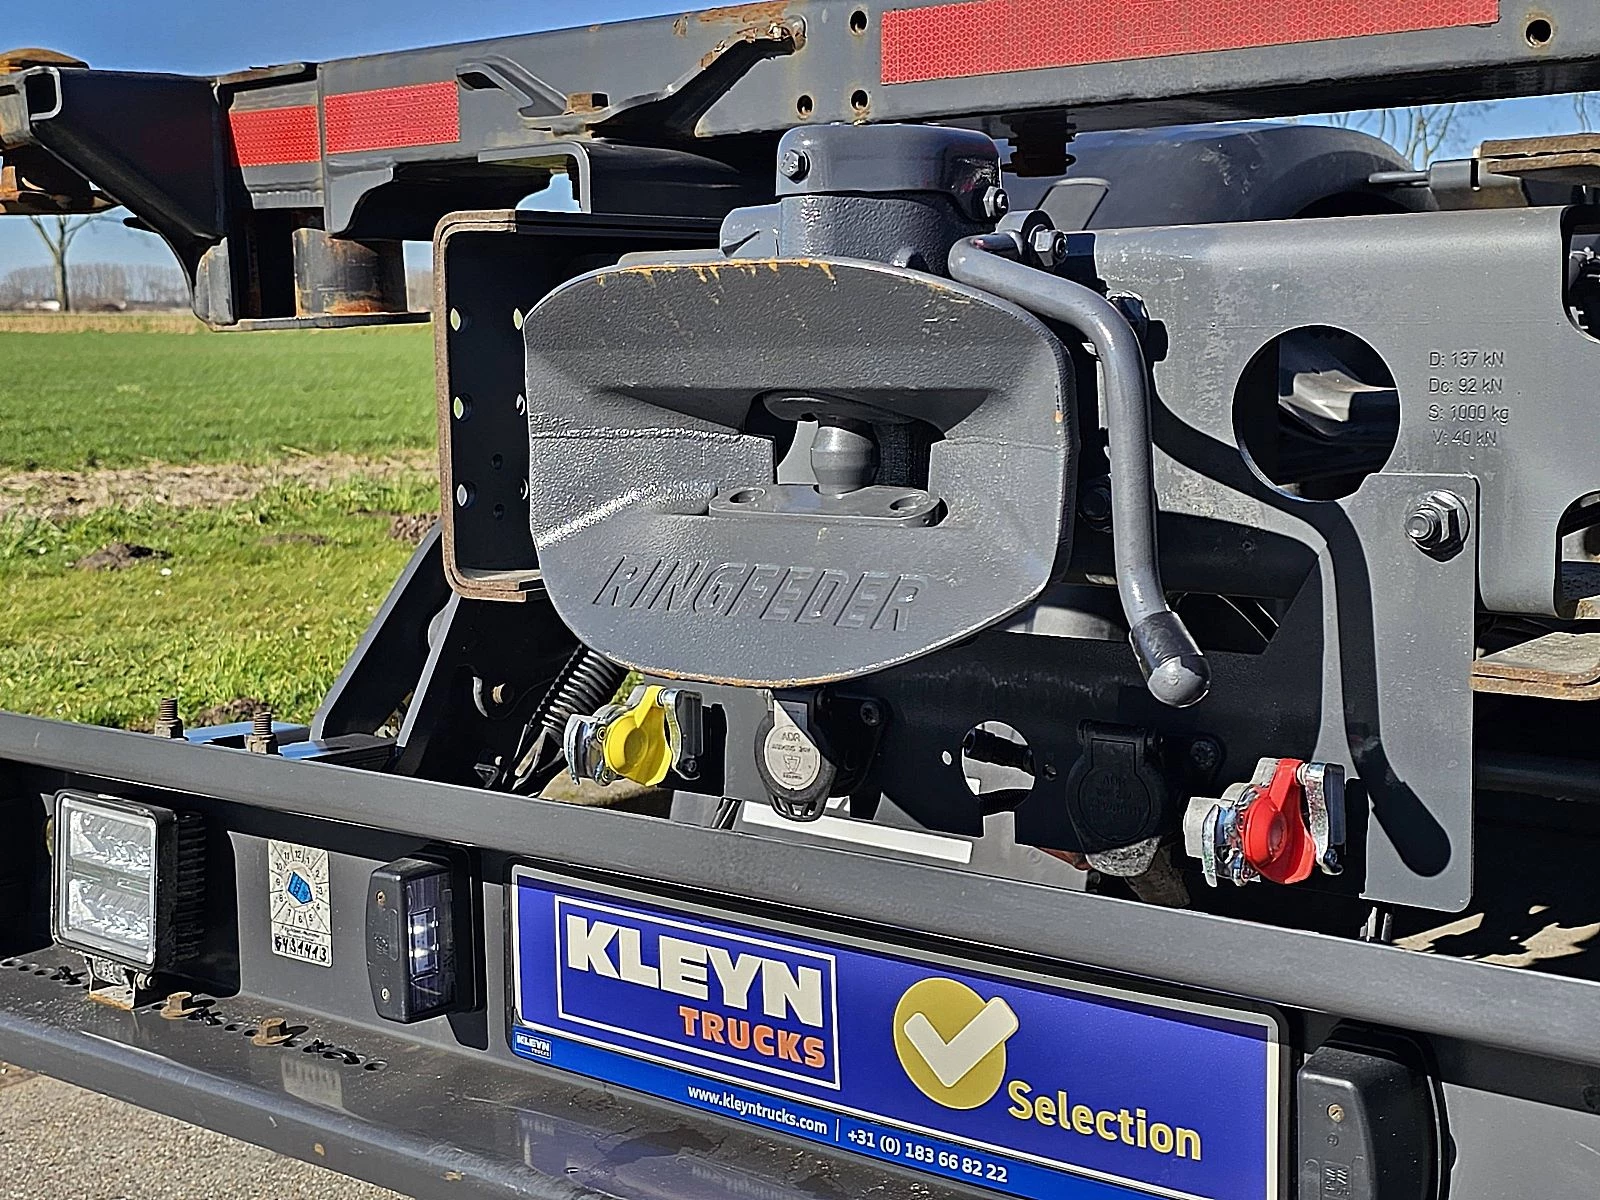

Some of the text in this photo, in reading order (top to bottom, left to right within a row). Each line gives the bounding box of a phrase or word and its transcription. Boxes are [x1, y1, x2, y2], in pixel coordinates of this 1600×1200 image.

[1429, 350, 1504, 368] D: 137 kN
[1428, 377, 1503, 395] Dc: 92 kN
[1428, 404, 1509, 426] S: 1000 kg
[1432, 429, 1497, 447] V: 40 kN
[592, 554, 927, 632] RINGFEDER
[284, 851, 290, 860] 11
[294, 850, 302, 859] 12
[566, 913, 824, 1028] KLEYN
[516, 1034, 550, 1052] KLEYN
[679, 1005, 826, 1069] TRUCKS
[1007, 1079, 1202, 1161] Selection
[687, 1085, 1008, 1183] www.kleyntrucks.com +31 (0) 183 66 82 22
